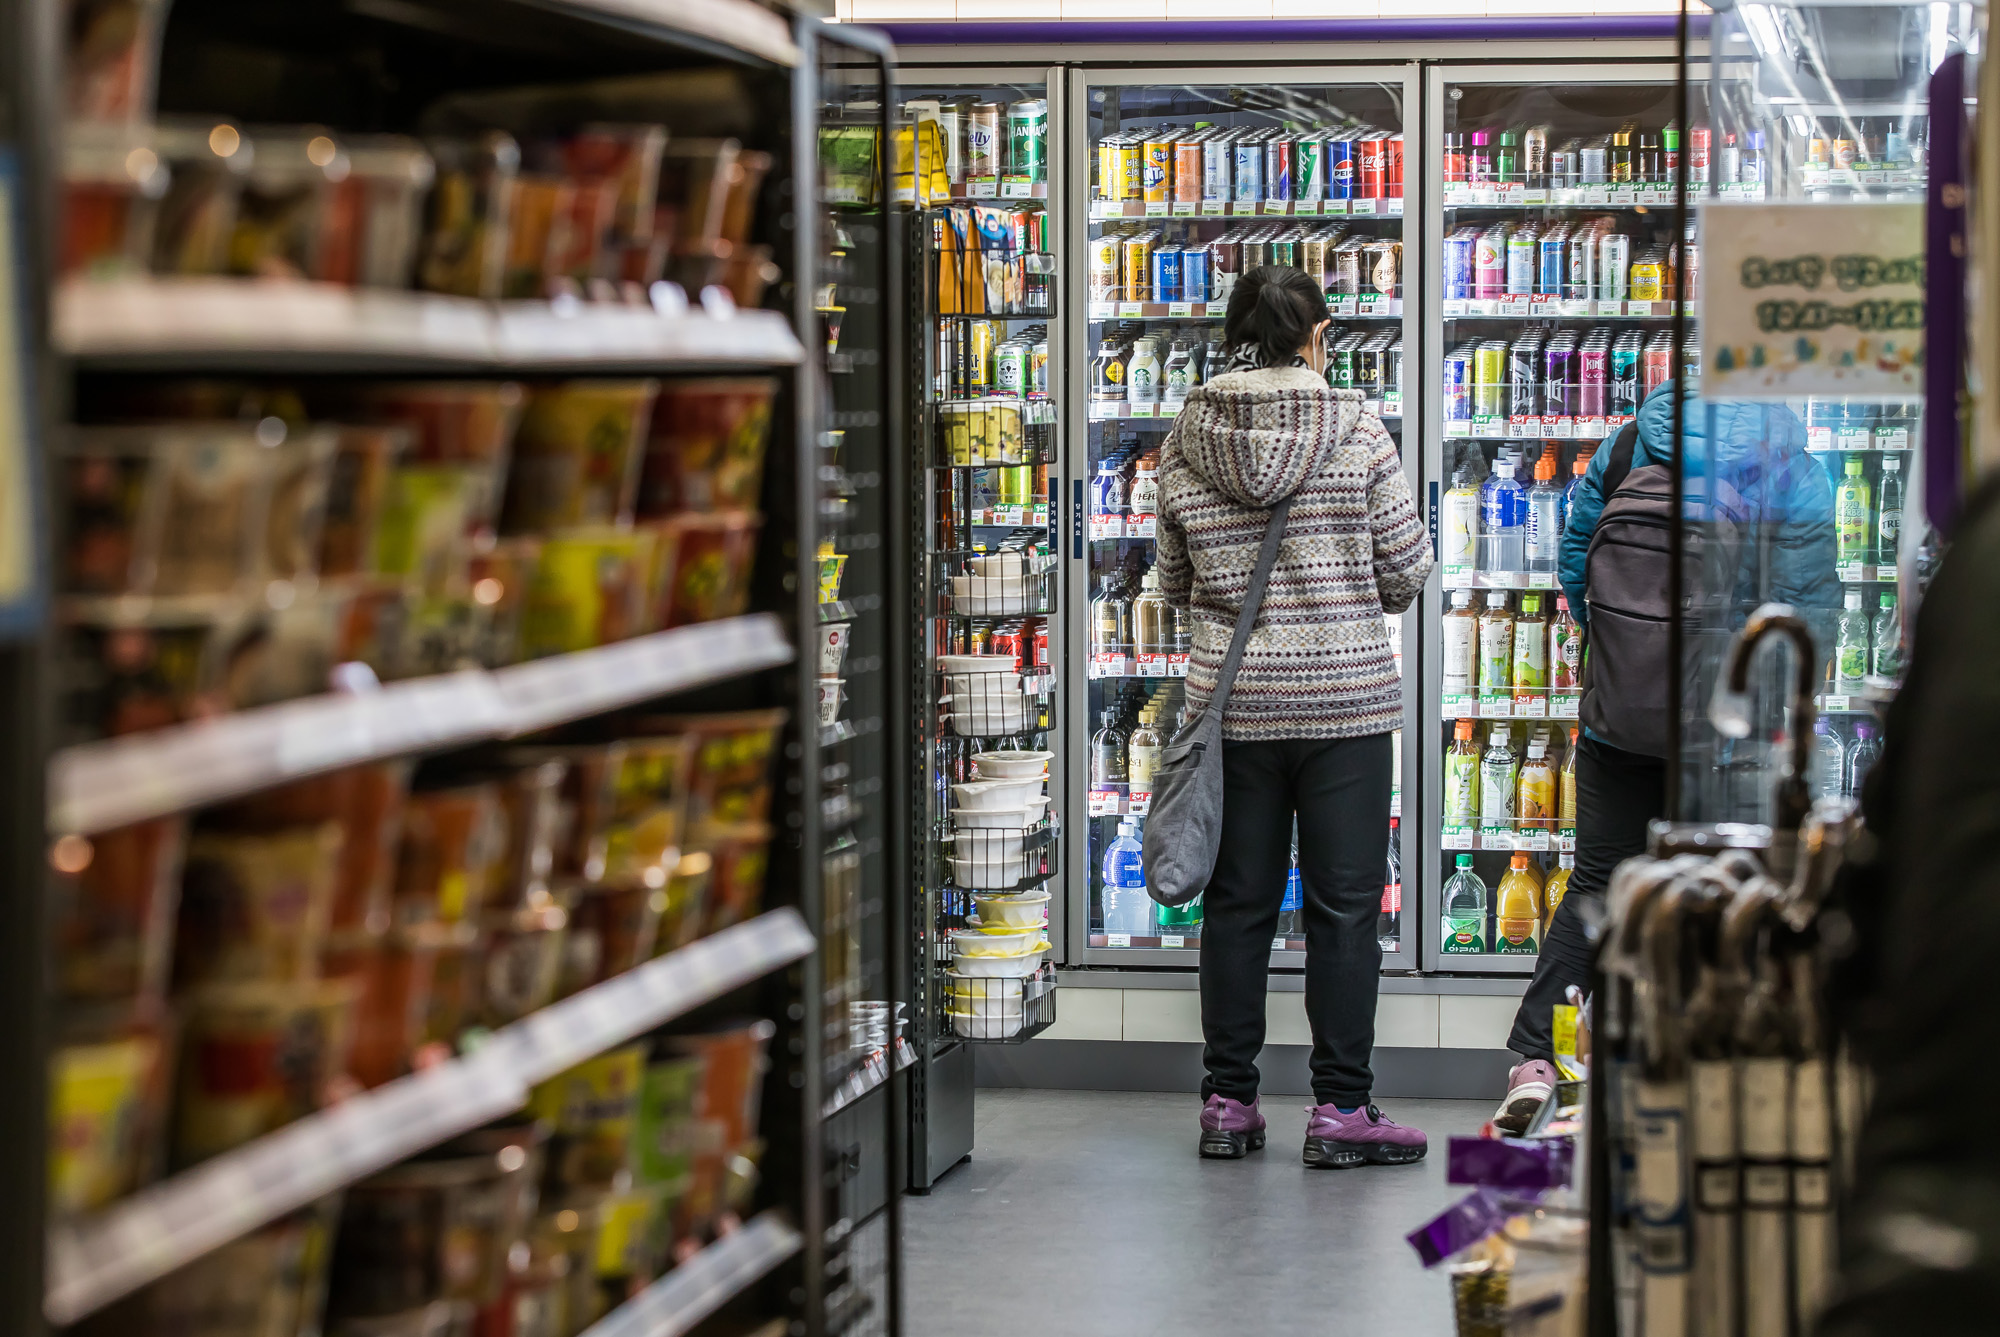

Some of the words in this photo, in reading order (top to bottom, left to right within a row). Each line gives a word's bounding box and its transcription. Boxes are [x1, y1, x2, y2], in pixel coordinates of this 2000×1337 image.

[1495, 183, 1509, 191] 2+1
[1655, 183, 1669, 191] 1+1
[1685, 183, 1699, 191] 1+1
[1327, 294, 1341, 302] 1+1
[1361, 294, 1375, 302] 1+1
[1585, 358, 1606, 371] KING
[1386, 393, 1400, 401] 1+1
[1512, 415, 1525, 423] 2+1
[1840, 428, 1854, 436] 1+1
[1877, 428, 1891, 436] 1+1
[995, 504, 1009, 512] 1+1
[1035, 504, 1048, 512] 1+1
[1094, 515, 1107, 523] 2+1
[1129, 515, 1142, 523] 2+1
[1882, 519, 1901, 529] TRE
[1444, 566, 1458, 574] 1+1
[1097, 654, 1110, 662] 2+1
[1139, 654, 1152, 662] 2+1
[1170, 654, 1183, 662] 2+1
[1443, 696, 1457, 704] 1+1
[1517, 695, 1530, 703] 2+1
[1551, 696, 1565, 704] 1+1
[1091, 792, 1104, 800] 2+1
[1131, 793, 1144, 801] 2+1
[1444, 826, 1458, 834] 1+1
[1483, 827, 1497, 835] 1+1
[1520, 829, 1534, 837] 1+1
[1560, 829, 1574, 837] 1+1
